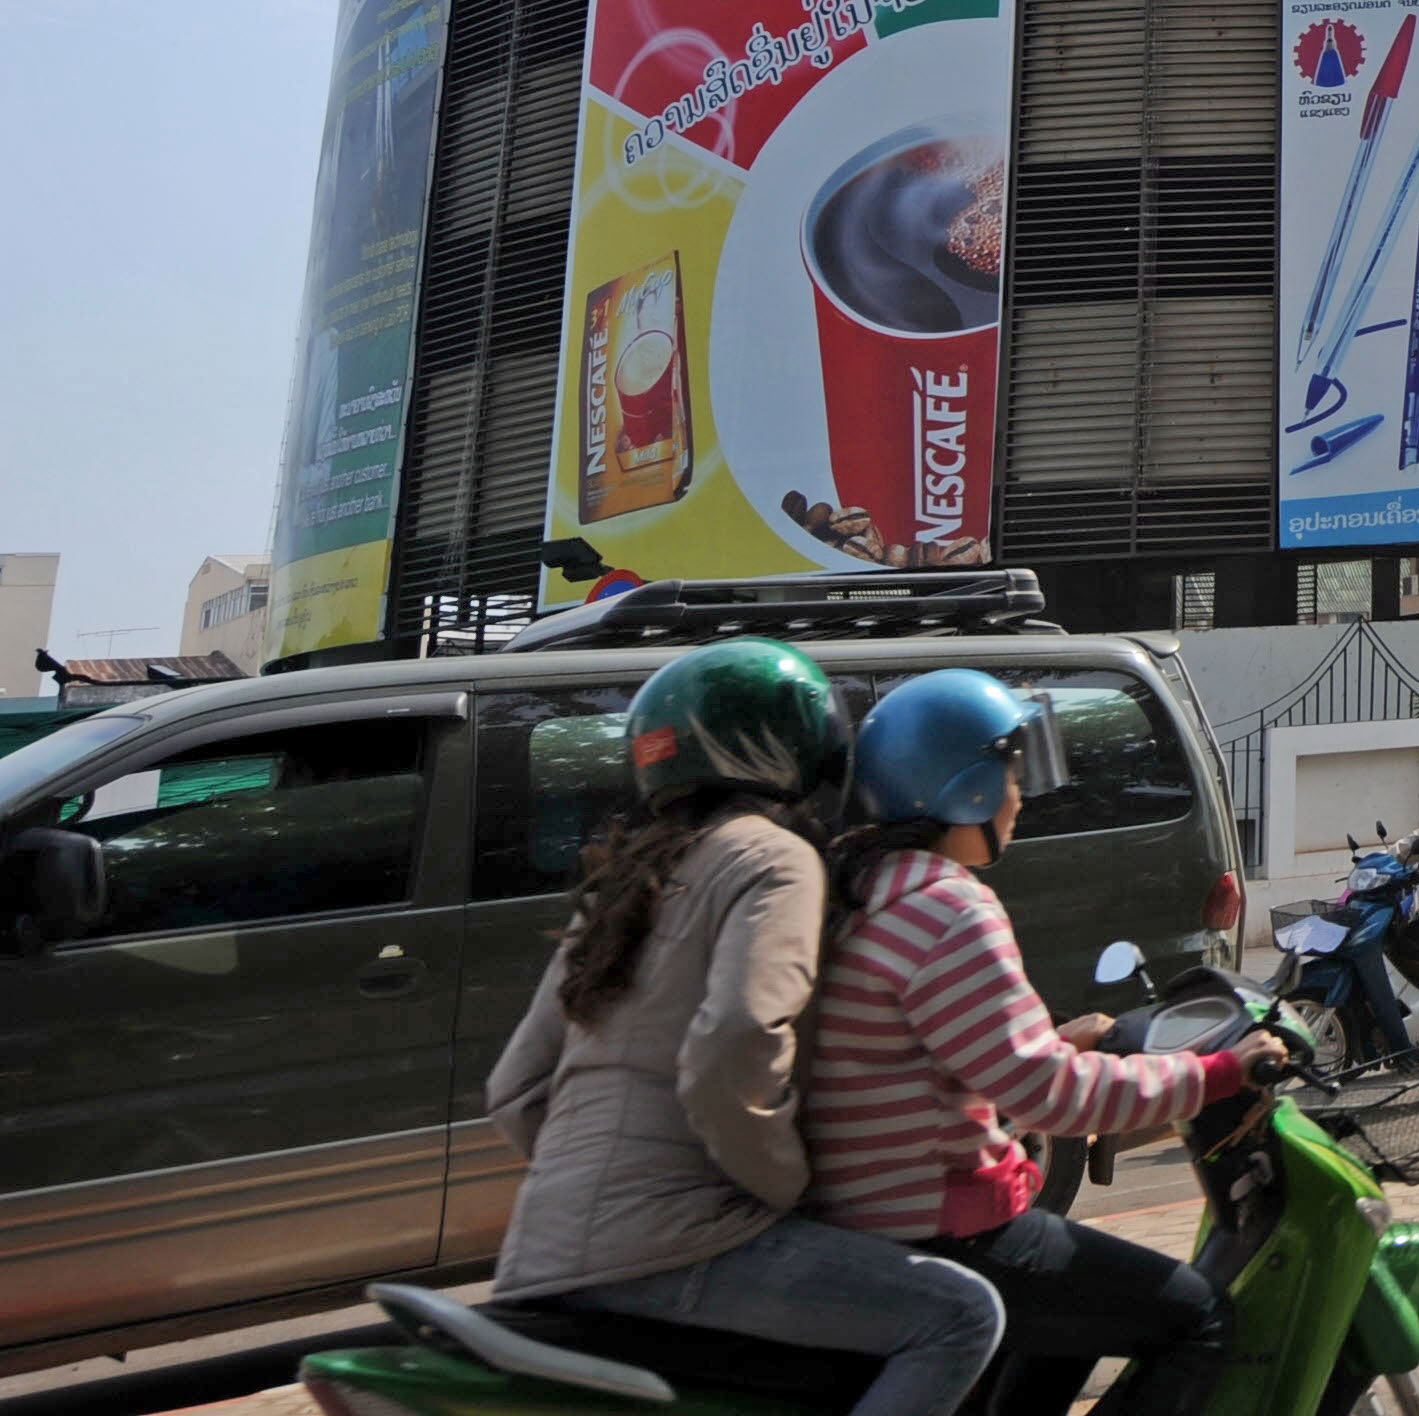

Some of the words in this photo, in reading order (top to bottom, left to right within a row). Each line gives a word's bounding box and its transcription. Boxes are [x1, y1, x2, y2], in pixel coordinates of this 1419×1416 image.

[1298, 89, 1352, 106] ຫົວຂຽນ
[587, 329, 609, 477] NESCAFÉ
[910, 366, 969, 546] NESCAFÉ
